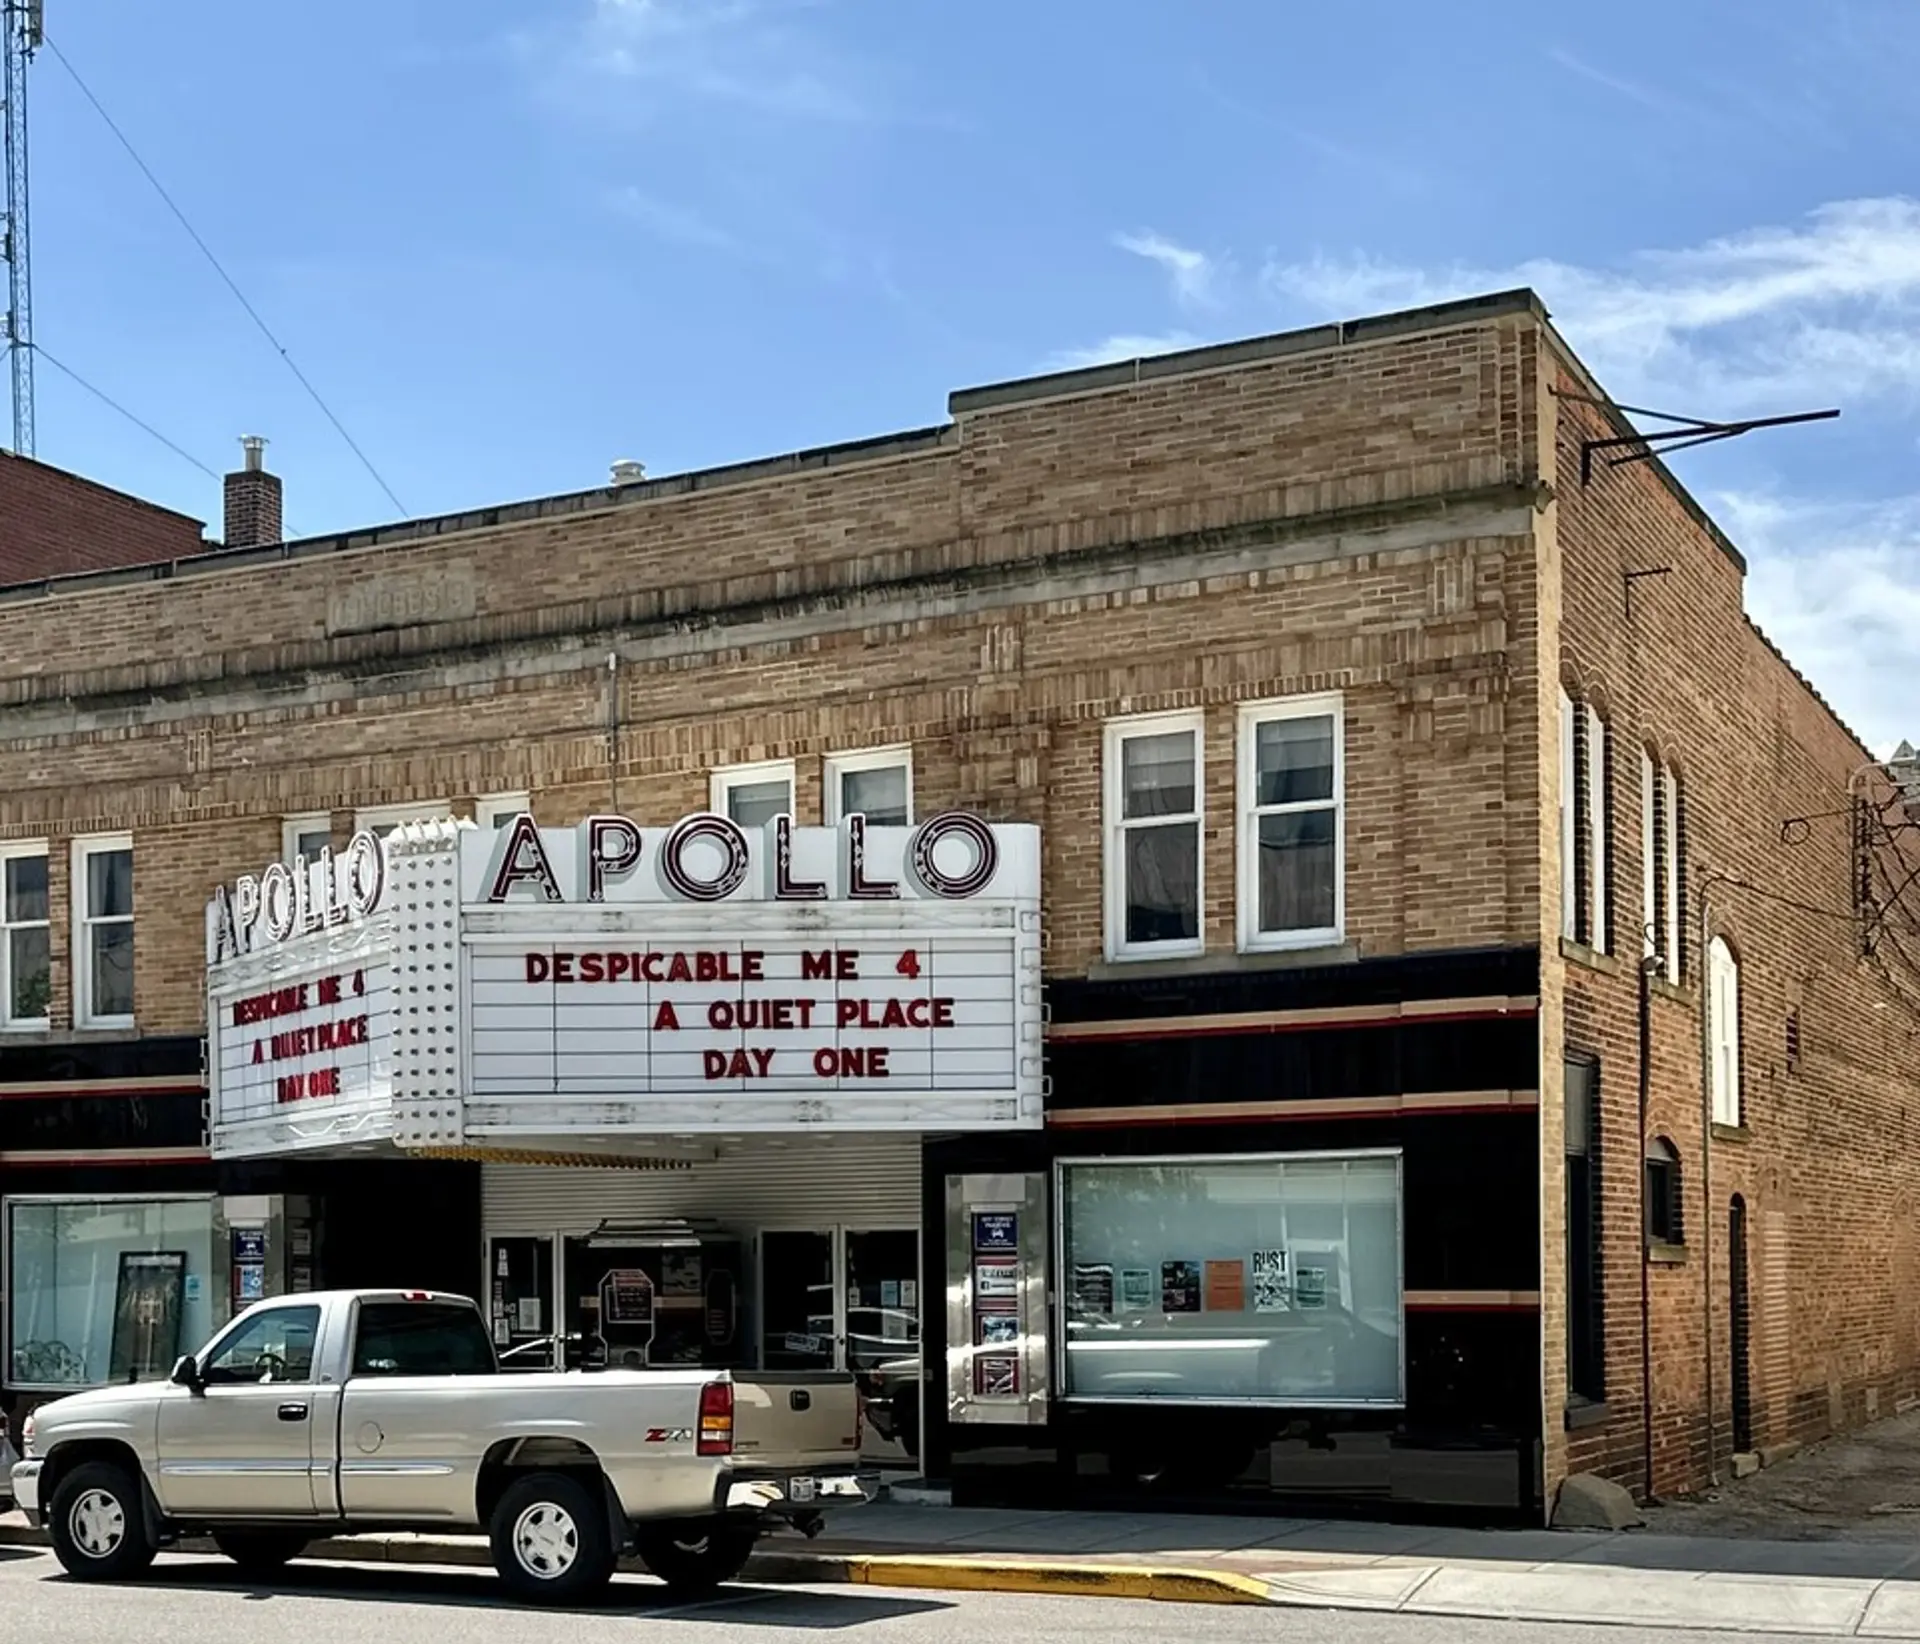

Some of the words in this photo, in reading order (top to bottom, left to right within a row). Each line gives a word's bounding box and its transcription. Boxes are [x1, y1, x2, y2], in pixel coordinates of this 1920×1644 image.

[484, 811, 1000, 903] APOLLO
[215, 830, 385, 965] APOLLO
[352, 969, 365, 997] 4
[525, 951, 766, 983] DESPICABLE
[801, 949, 860, 980] ME
[895, 949, 922, 979] 4
[652, 1000, 681, 1031] A
[707, 998, 817, 1030] QUIET
[836, 996, 955, 1028] PLACE
[251, 1038, 264, 1065] A
[271, 1026, 317, 1061] QUIET
[317, 1013, 370, 1052] PLACE
[703, 1047, 777, 1080] DAY
[813, 1046, 890, 1077] ONE
[276, 1073, 305, 1104] DAY
[308, 1066, 341, 1098] ONE
[1253, 1250, 1287, 1274] RUST
